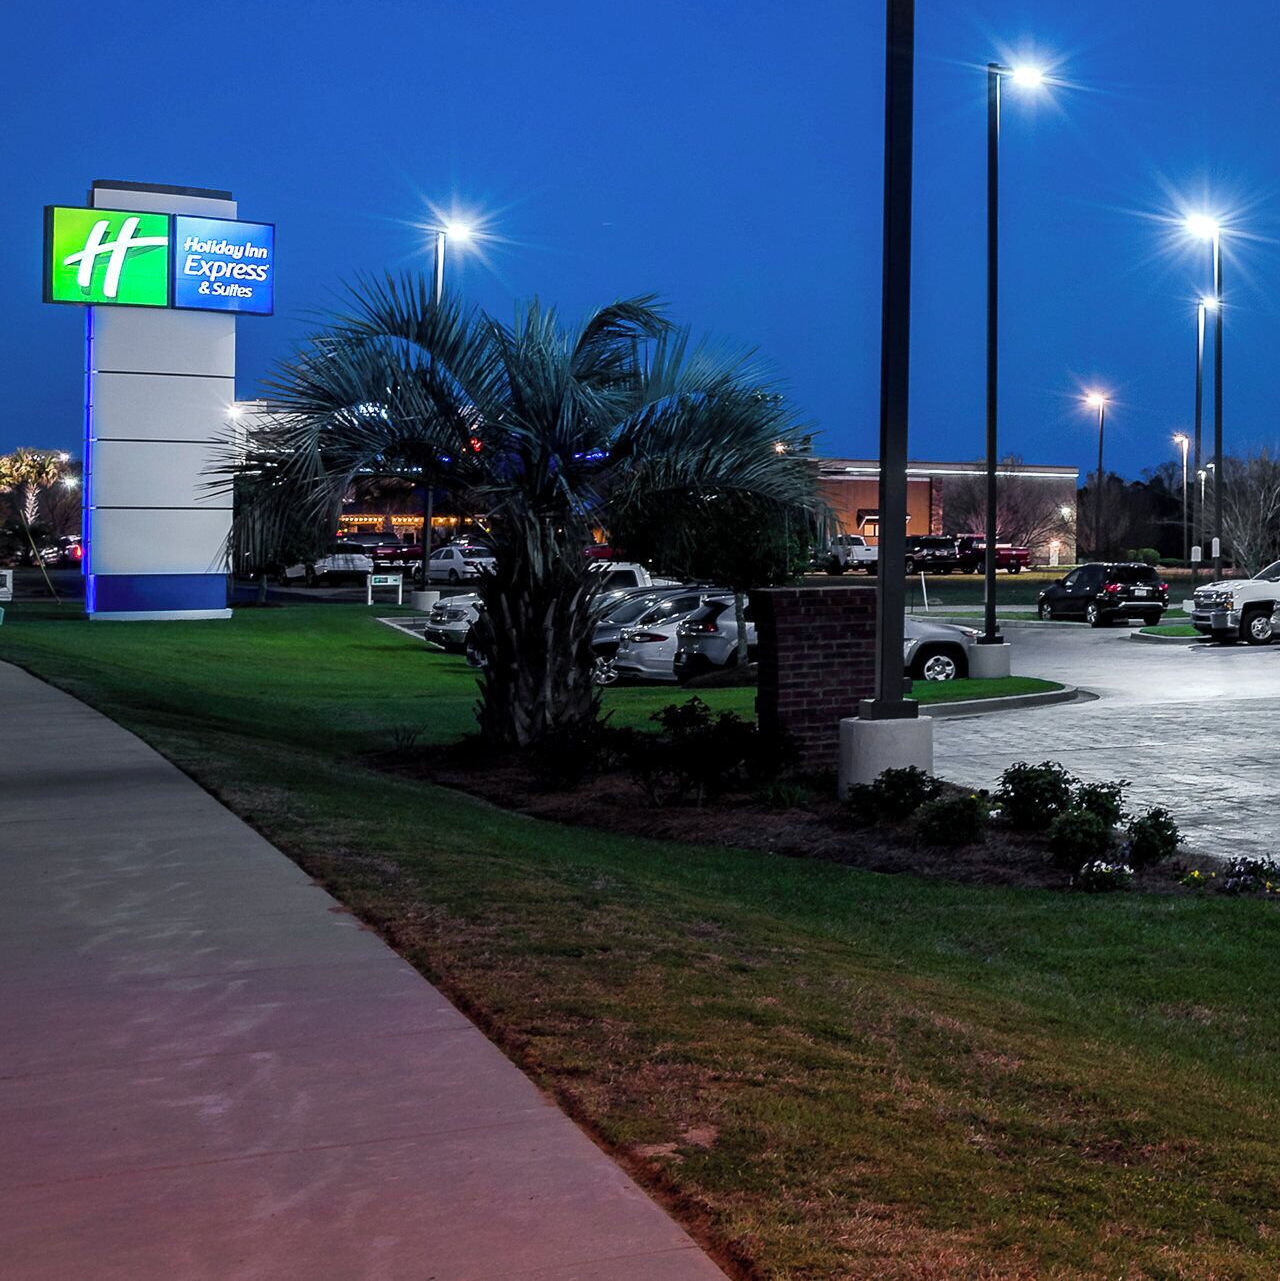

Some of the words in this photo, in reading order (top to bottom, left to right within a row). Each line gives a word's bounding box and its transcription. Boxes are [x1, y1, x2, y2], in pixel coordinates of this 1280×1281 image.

[183, 236, 244, 260] Holiday
[244, 242, 268, 259] Inn
[183, 254, 268, 282] Express
[198, 280, 210, 295] &
[211, 282, 253, 298] Suites
